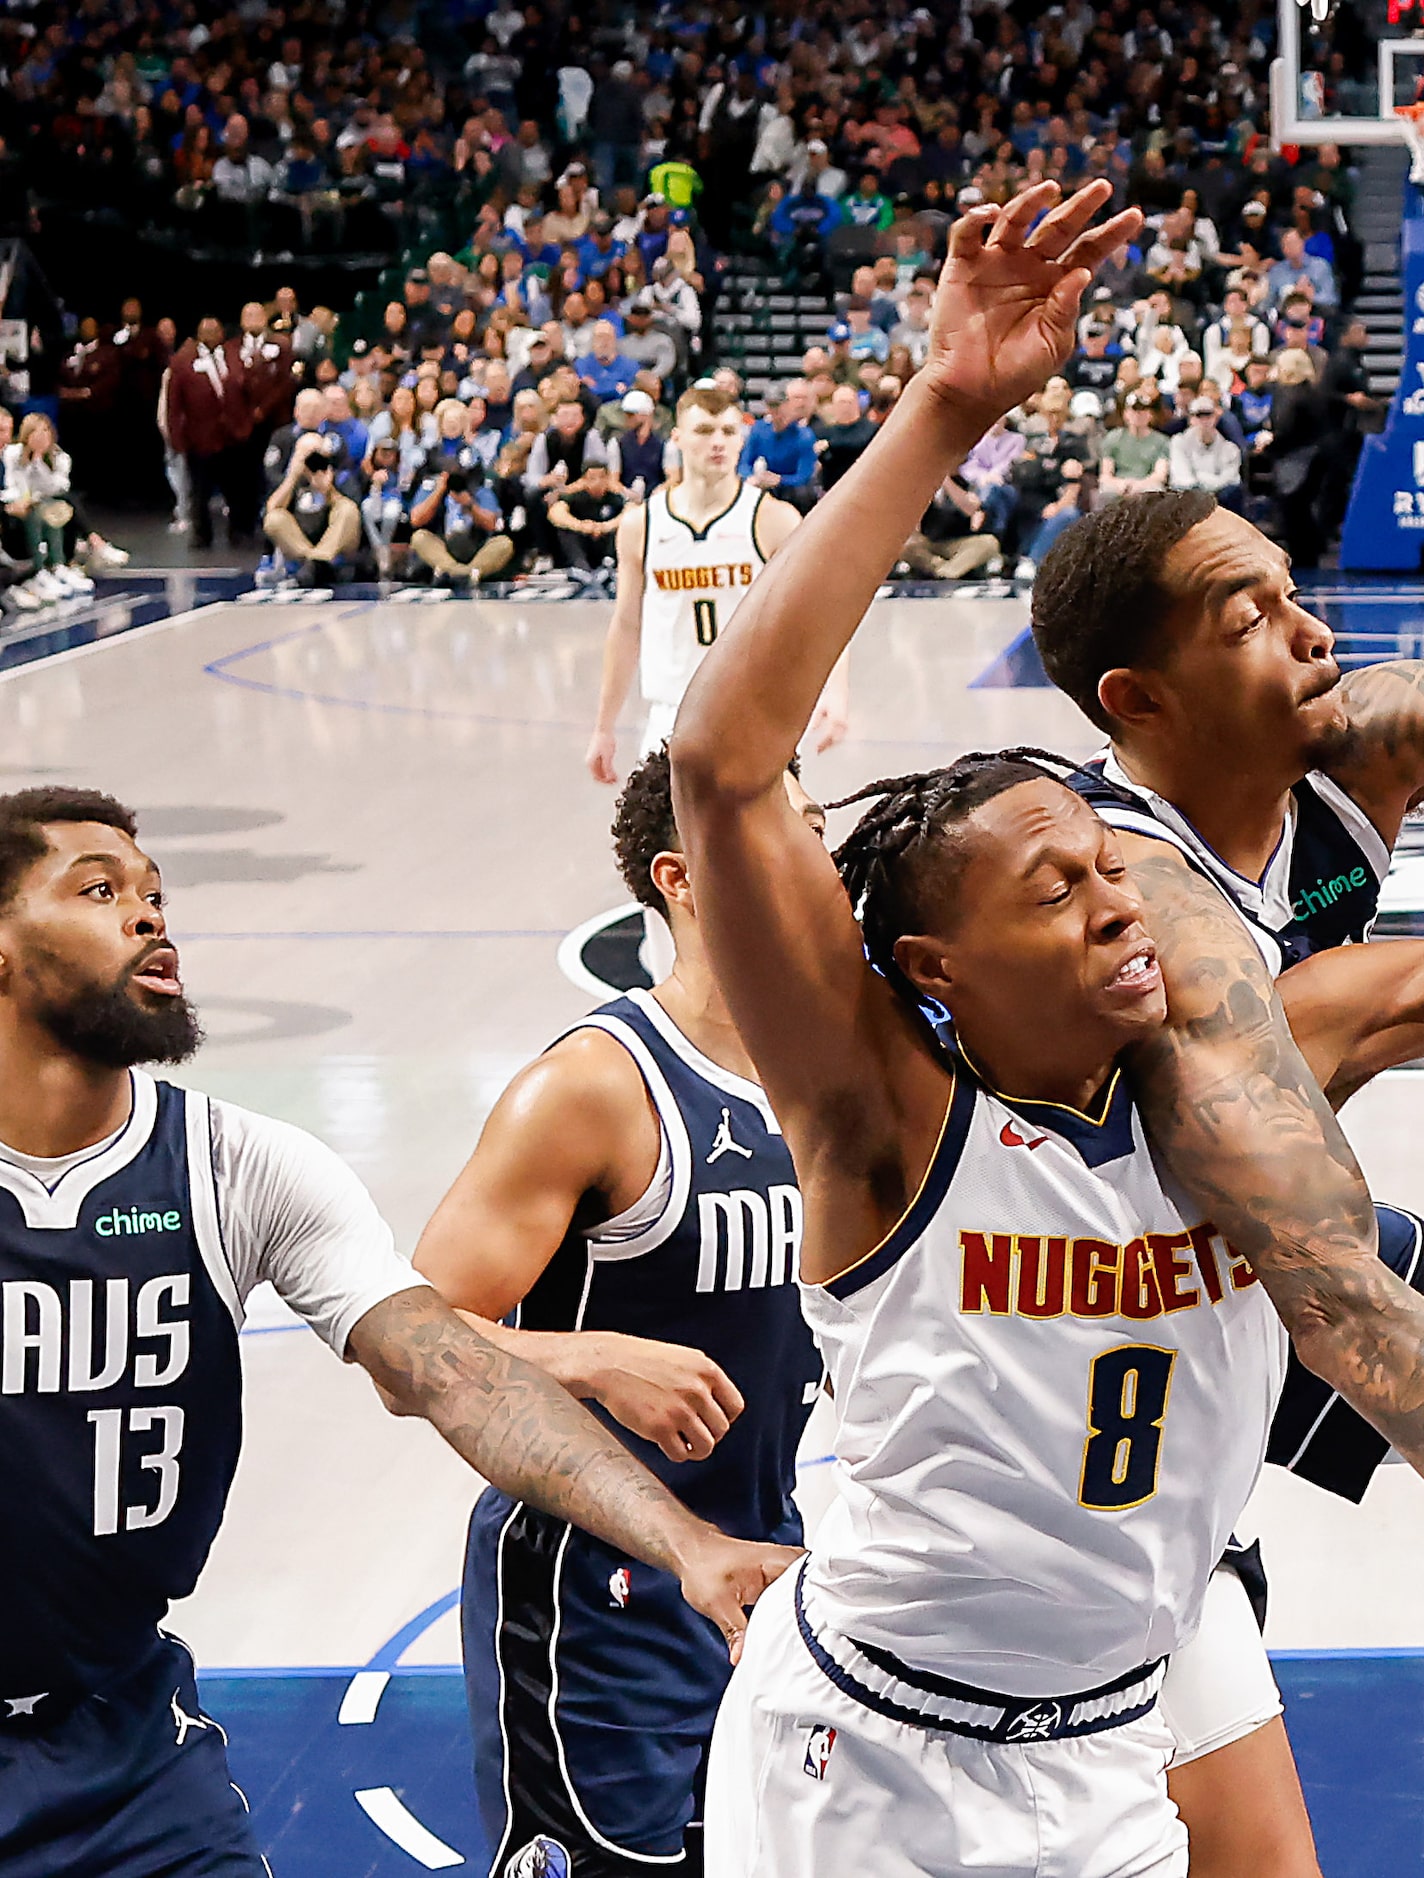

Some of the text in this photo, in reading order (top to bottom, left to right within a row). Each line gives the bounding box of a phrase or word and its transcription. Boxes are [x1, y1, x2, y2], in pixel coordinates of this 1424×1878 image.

[652, 562, 753, 591] NUGGETS
[693, 599, 718, 645] 0
[1292, 866, 1367, 921] chime
[95, 1206, 181, 1236] chime
[695, 1184, 803, 1292] MA
[1, 1273, 190, 1395] AVS
[1077, 1343, 1178, 1512] 8
[86, 1405, 185, 1536] 13
